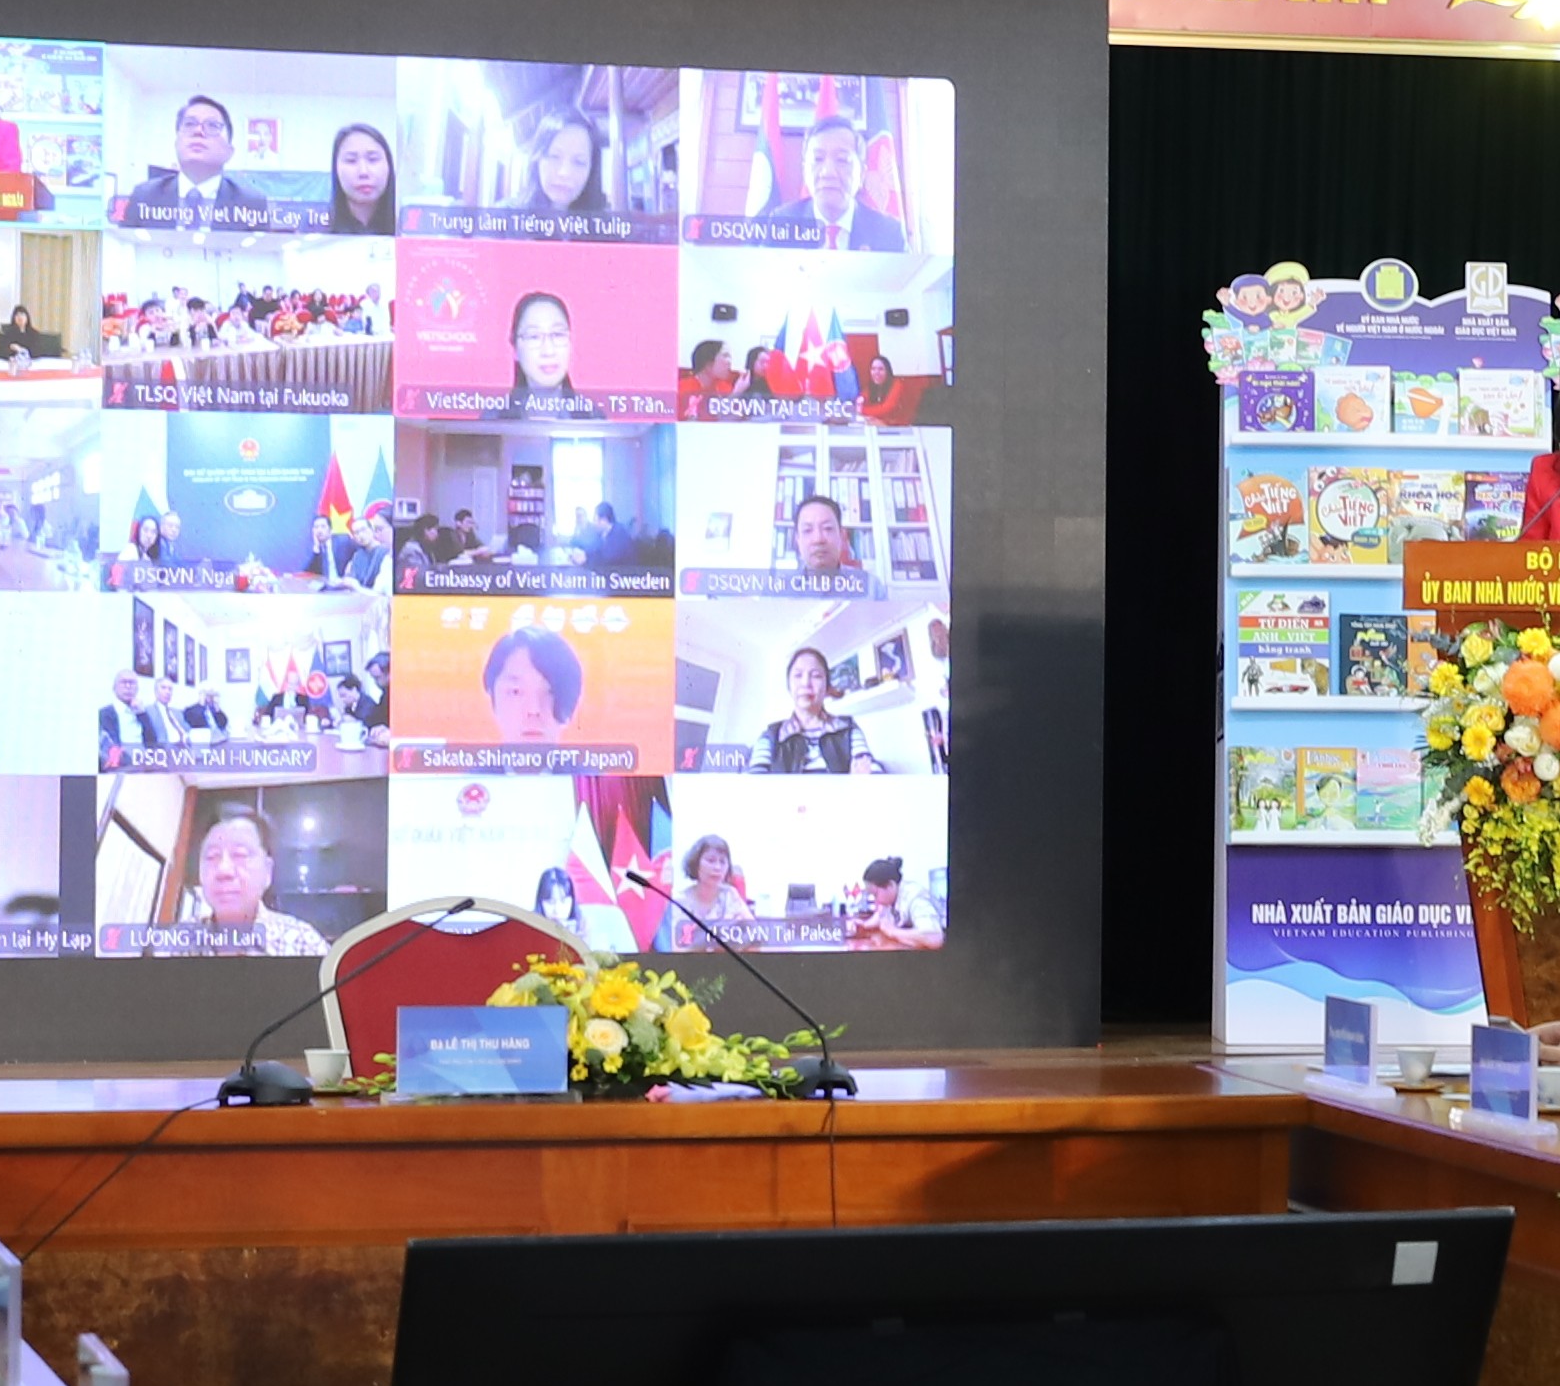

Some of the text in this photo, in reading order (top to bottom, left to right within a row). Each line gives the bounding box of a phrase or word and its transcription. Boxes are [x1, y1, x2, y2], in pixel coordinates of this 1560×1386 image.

[592, 216, 631, 238] Tulip
[135, 384, 349, 408] TLSQ Việt Nam tại Fukuoka
[425, 391, 510, 411] VietSchool
[525, 392, 593, 412] Australia
[608, 395, 627, 413] TS
[1526, 546, 1553, 576] BỘ
[425, 569, 491, 592] Embassy
[496, 570, 513, 589] of
[550, 573, 588, 590] Nam
[591, 572, 606, 590] in
[609, 572, 670, 591] Sweden
[791, 573, 831, 593] CHLB
[1422, 571, 1440, 604] ỦY
[1443, 580, 1472, 604] BAN
[1475, 575, 1504, 605] NHÀ
[1507, 574, 1545, 605] NƯỚC
[1252, 629, 1279, 642] ANH
[1284, 645, 1312, 654] tranh
[230, 749, 313, 767] HUNGARY
[422, 748, 634, 771] Sakata.Shintaro (FPT Japan)
[705, 749, 746, 767] Minh
[1252, 897, 1474, 929] NHÀ XUẤT BẢN GIÁO DỤC VI
[36, 932, 57, 952] Hy
[232, 930, 263, 946] Lan
[1273, 928, 1474, 939] VIETNAM EDUCATION PUBLISHING
